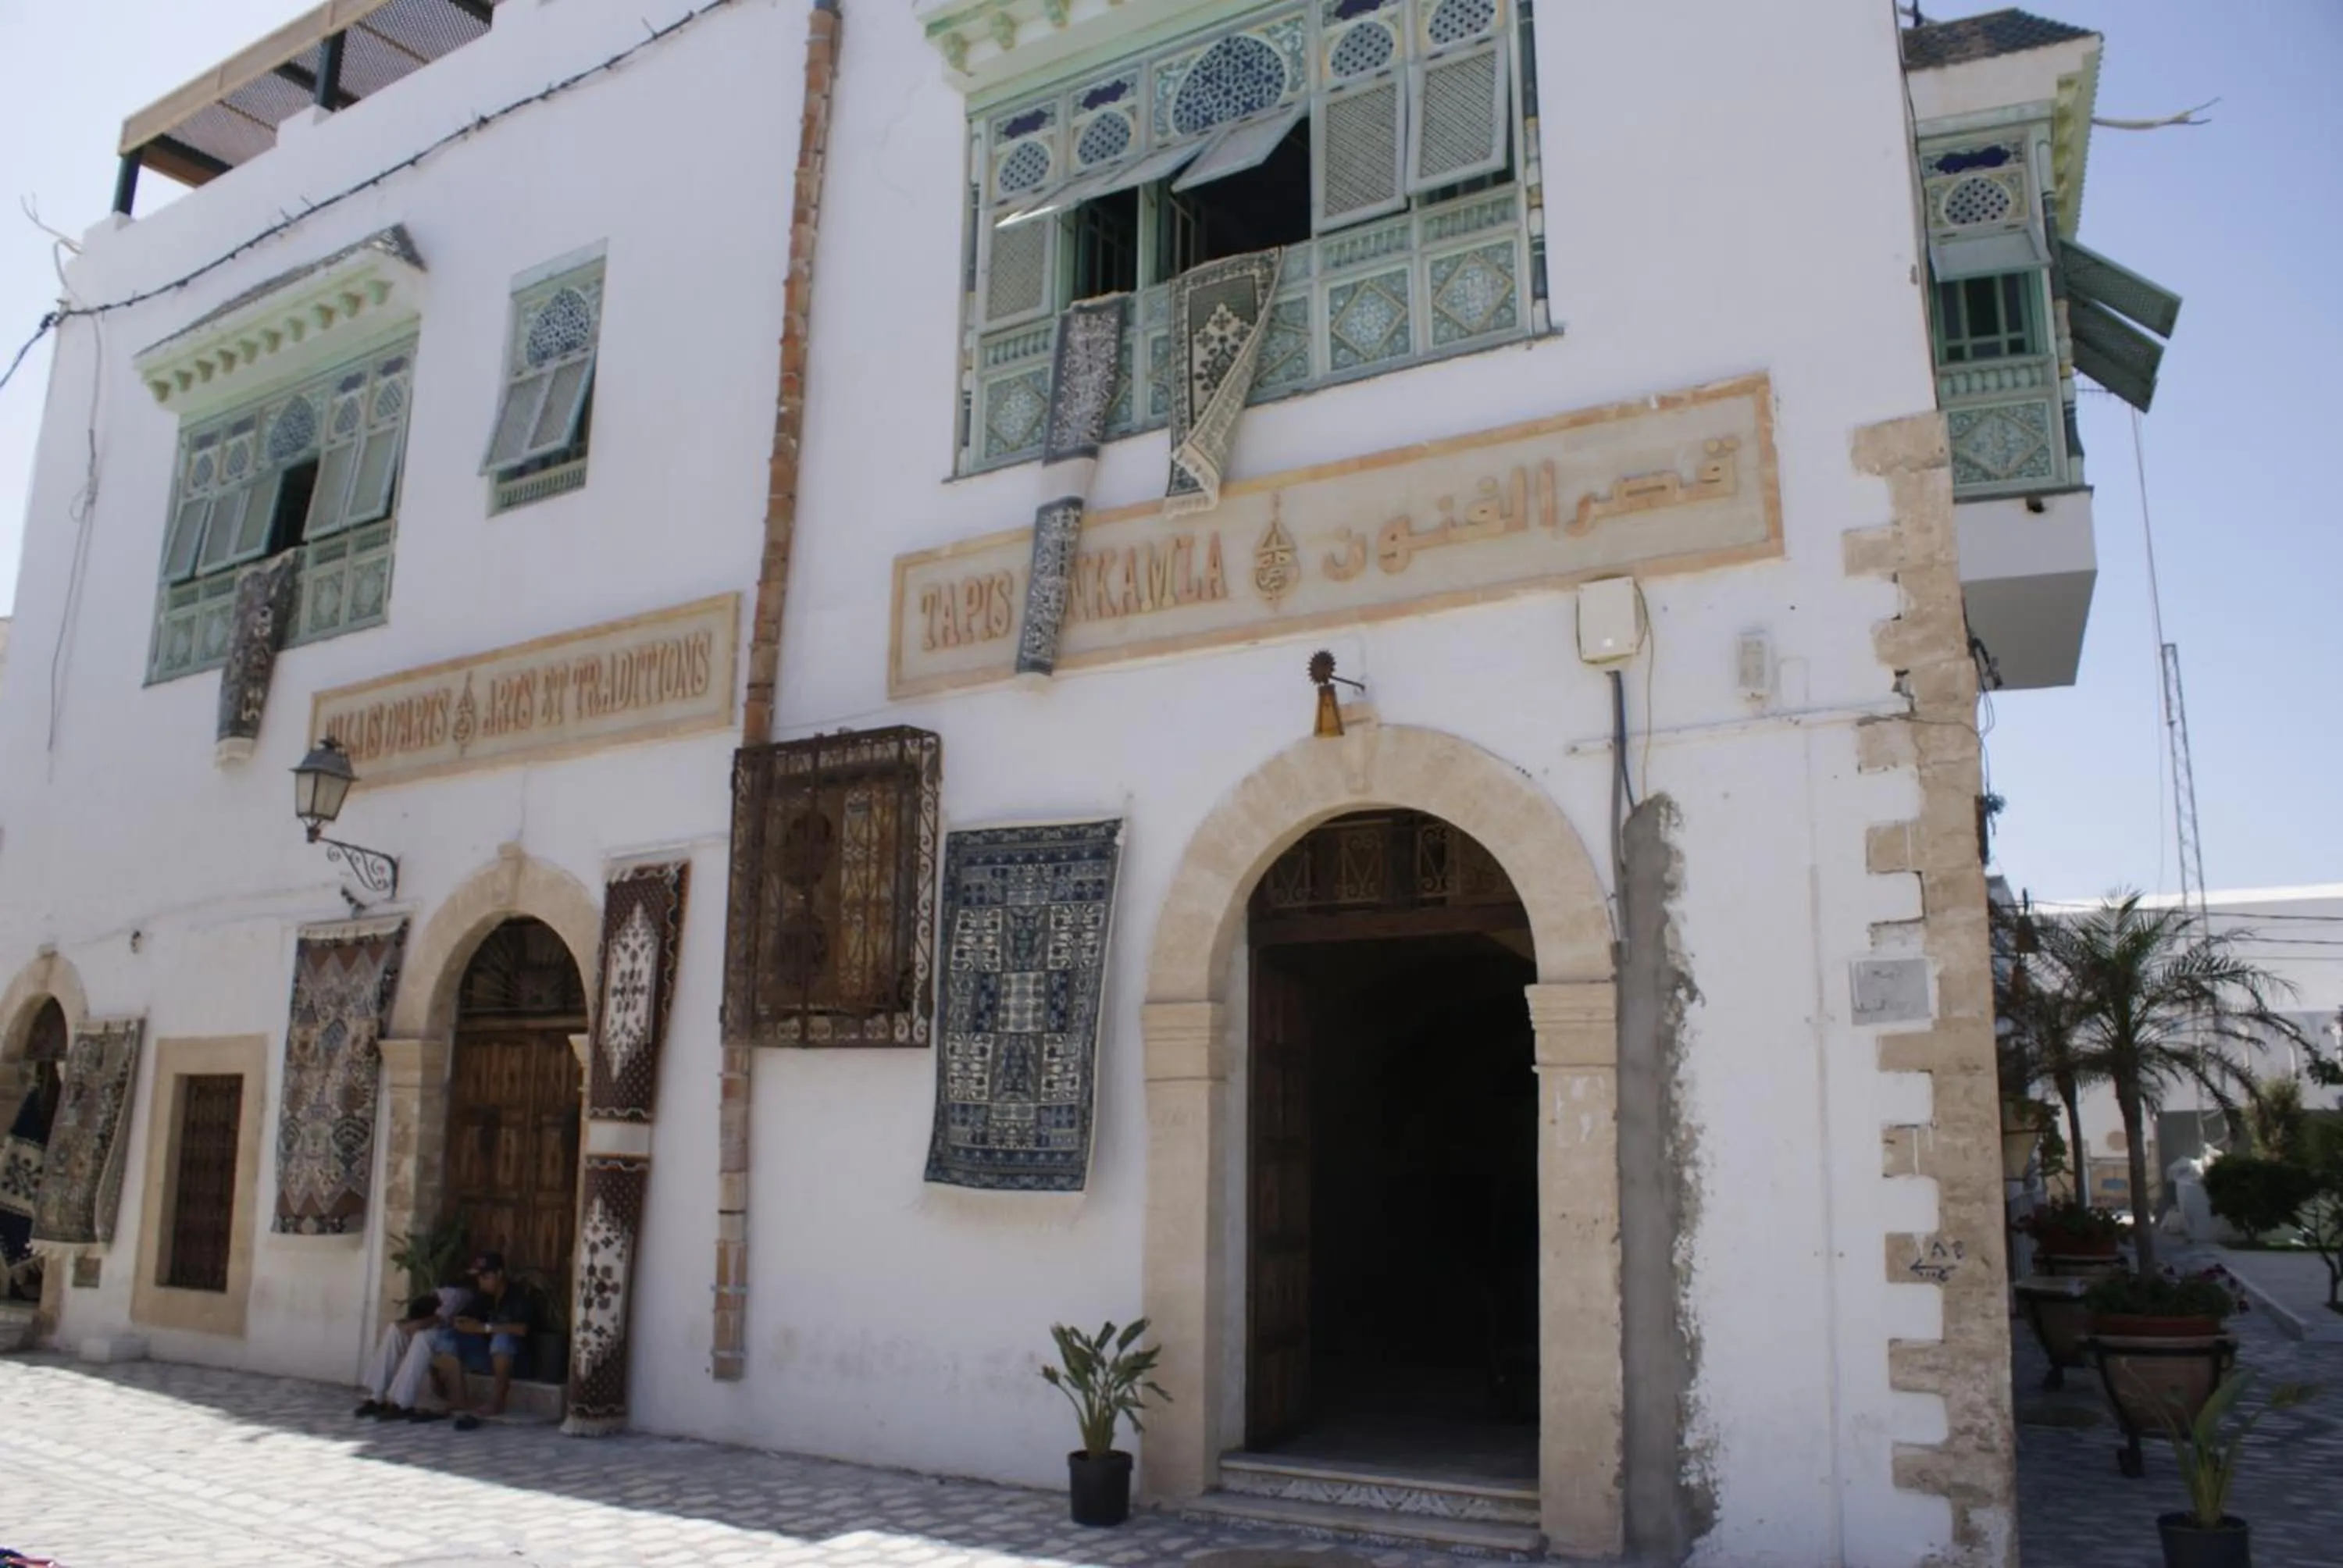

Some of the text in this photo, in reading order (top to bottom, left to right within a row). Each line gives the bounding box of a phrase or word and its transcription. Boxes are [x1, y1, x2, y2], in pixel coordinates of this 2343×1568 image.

[1320, 435, 1740, 582] قصر الفنون
[920, 530, 1229, 651] TAPIS NKAMLA
[481, 668, 537, 736] ARTS
[540, 661, 571, 726] ET
[571, 629, 713, 719] TRADITIONS
